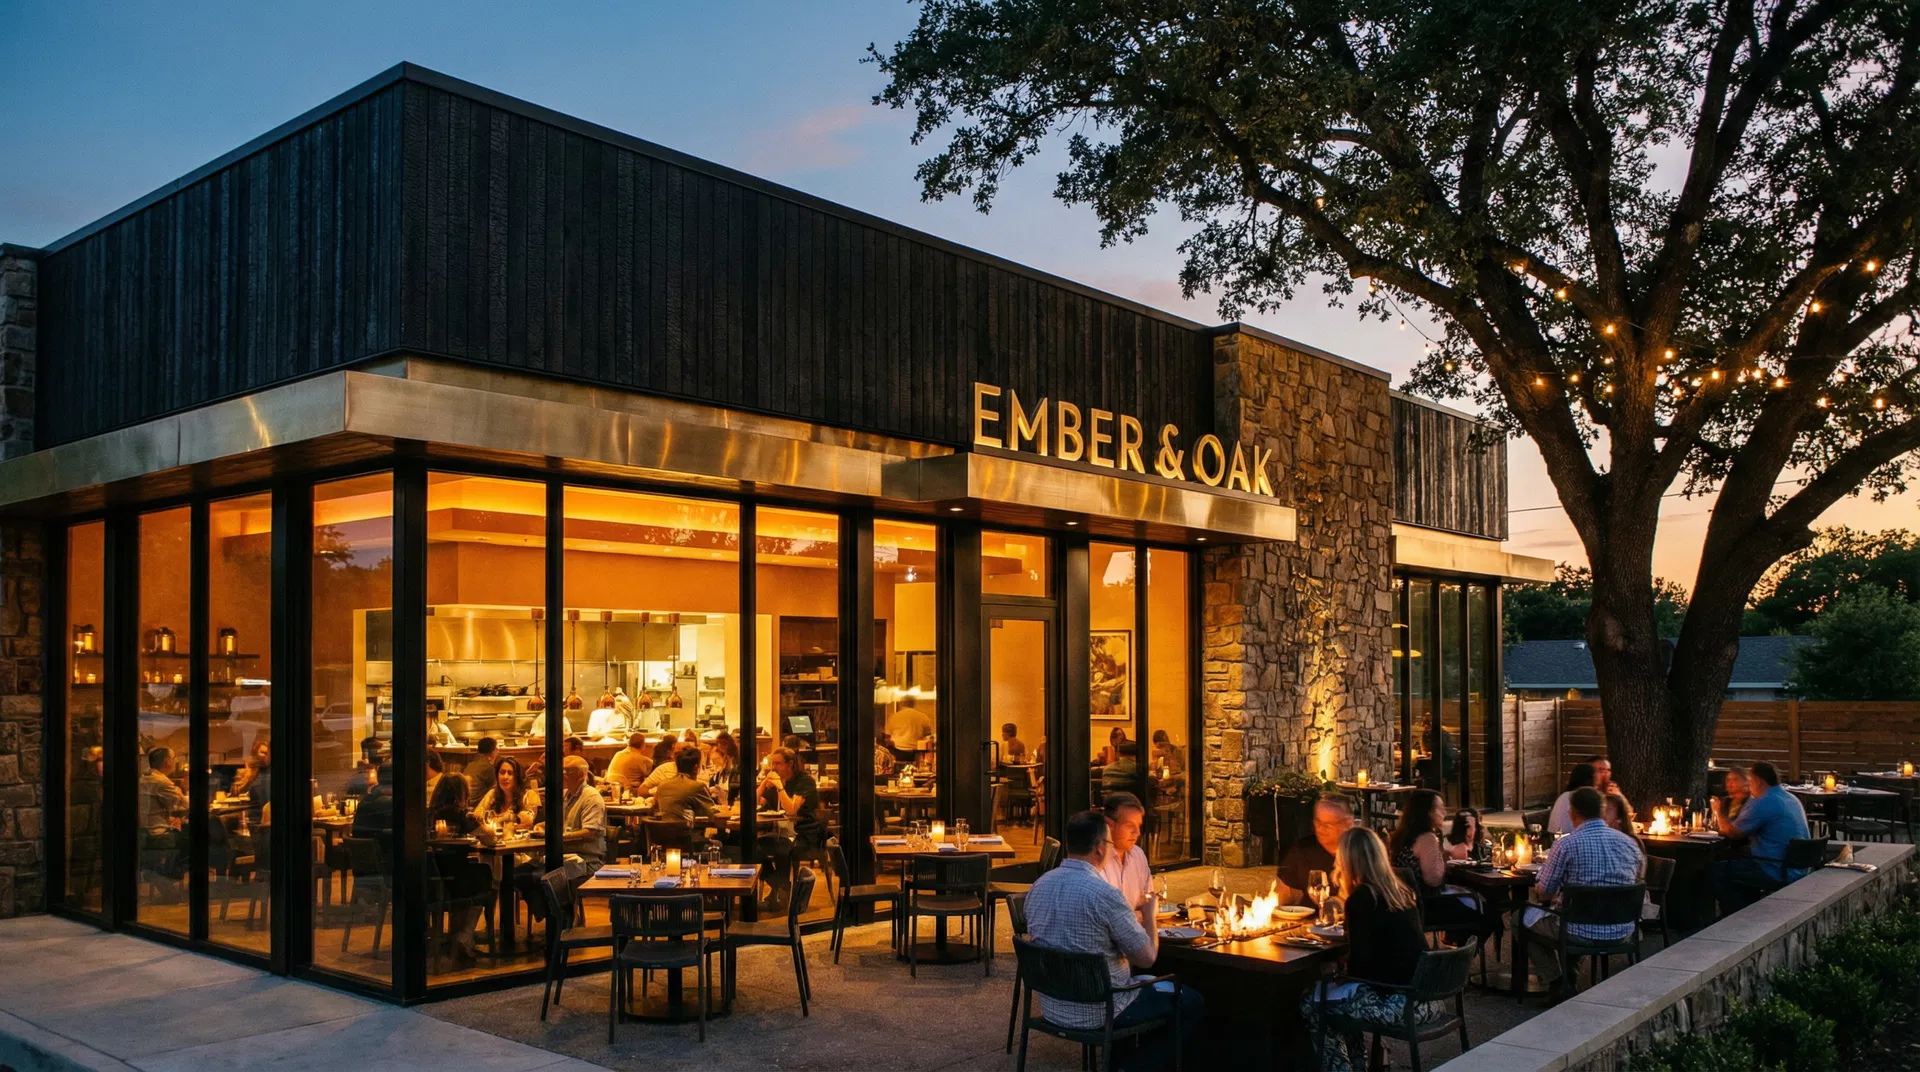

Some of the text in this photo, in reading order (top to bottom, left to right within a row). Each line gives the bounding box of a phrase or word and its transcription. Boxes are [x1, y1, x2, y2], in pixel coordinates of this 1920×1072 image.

[974, 382, 1274, 497] EMBER & OAK
